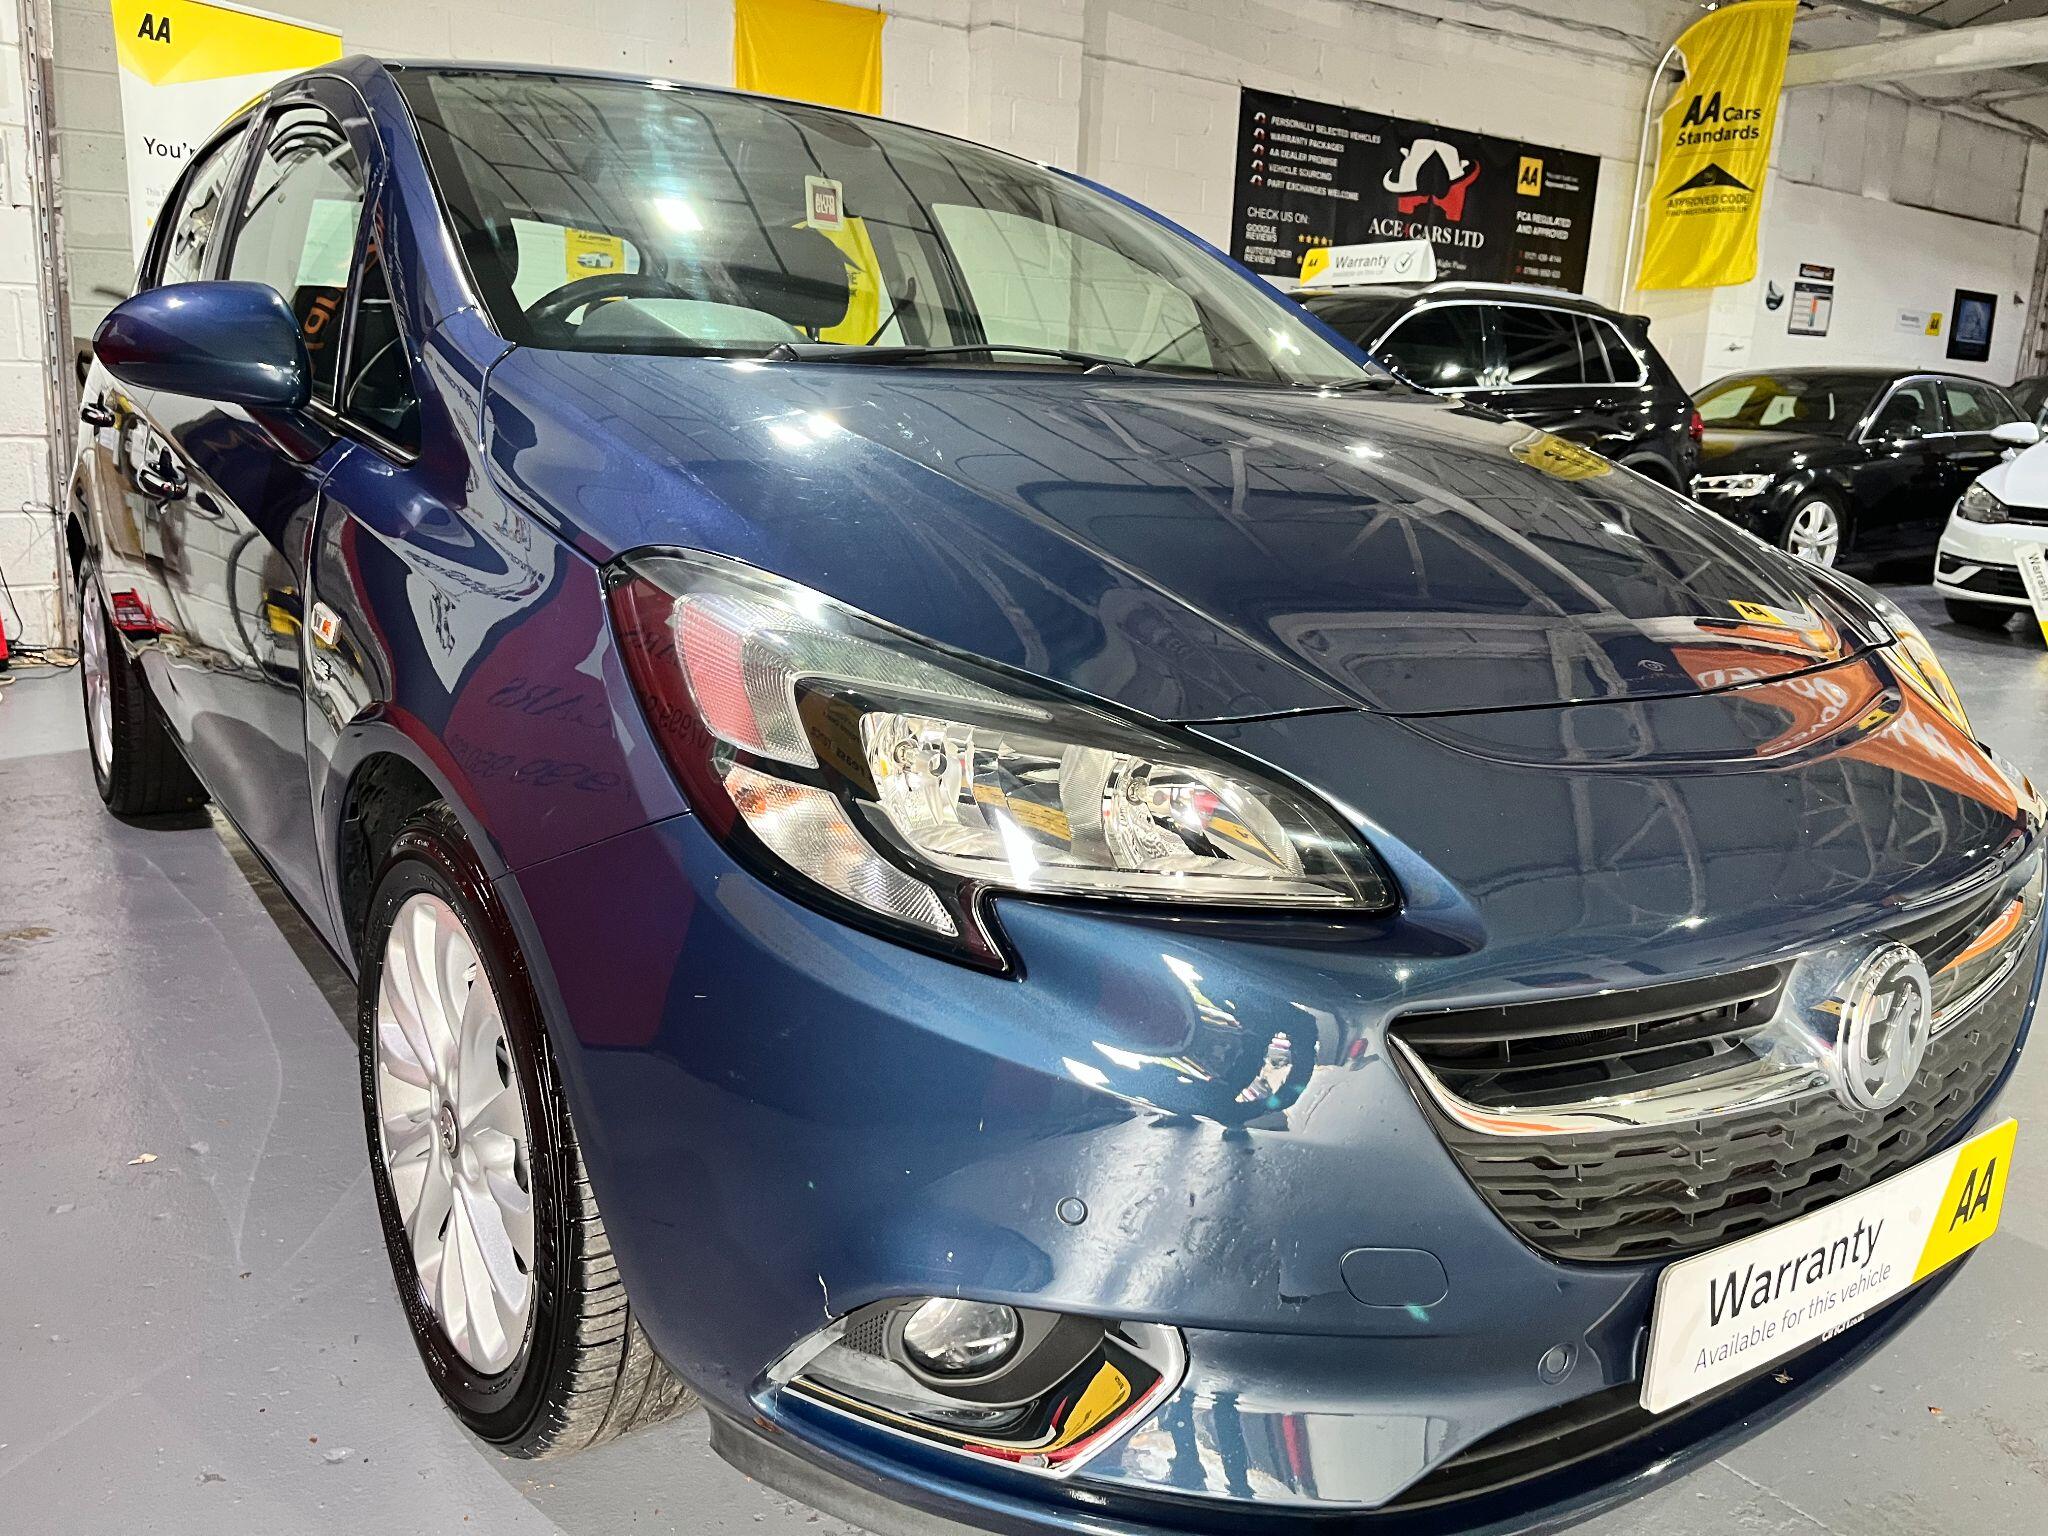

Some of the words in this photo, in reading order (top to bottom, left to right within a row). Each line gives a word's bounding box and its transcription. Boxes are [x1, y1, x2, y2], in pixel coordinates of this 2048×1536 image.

[138, 13, 170, 43] AA
[1681, 91, 1721, 127] AA
[1723, 107, 1761, 121] Cars
[1270, 132, 1308, 146] WARRANTY
[1308, 138, 1344, 153] PACKAGES
[1315, 124, 1349, 138] SELECTED
[1349, 130, 1381, 144] VEHICLES
[1676, 125, 1759, 146] Standards
[1269, 147, 1280, 157] AA
[1280, 149, 1307, 161] DEALER
[1268, 163, 1298, 176] VEHICLE
[1299, 168, 1333, 181] SOURCING
[1520, 166, 1538, 186] AA
[1247, 206, 1279, 221] CHECK
[1280, 210, 1294, 222] US
[1245, 223, 1277, 235] GOOGLE
[1245, 232, 1278, 243] REVIEWS
[1368, 217, 1404, 238] ACE
[1409, 222, 1452, 244] CARS
[1454, 229, 1485, 249] LTD
[1244, 254, 1276, 265] REVIEWS
[1335, 254, 1390, 271] Warranty
[1708, 1216, 1885, 1327] Warranty
[1948, 1157, 1997, 1233] AA
[1693, 1317, 1776, 1373] Available
[1778, 1303, 1807, 1337] for
[1807, 1288, 1839, 1322] this
[1839, 1262, 1892, 1311] vehicle
